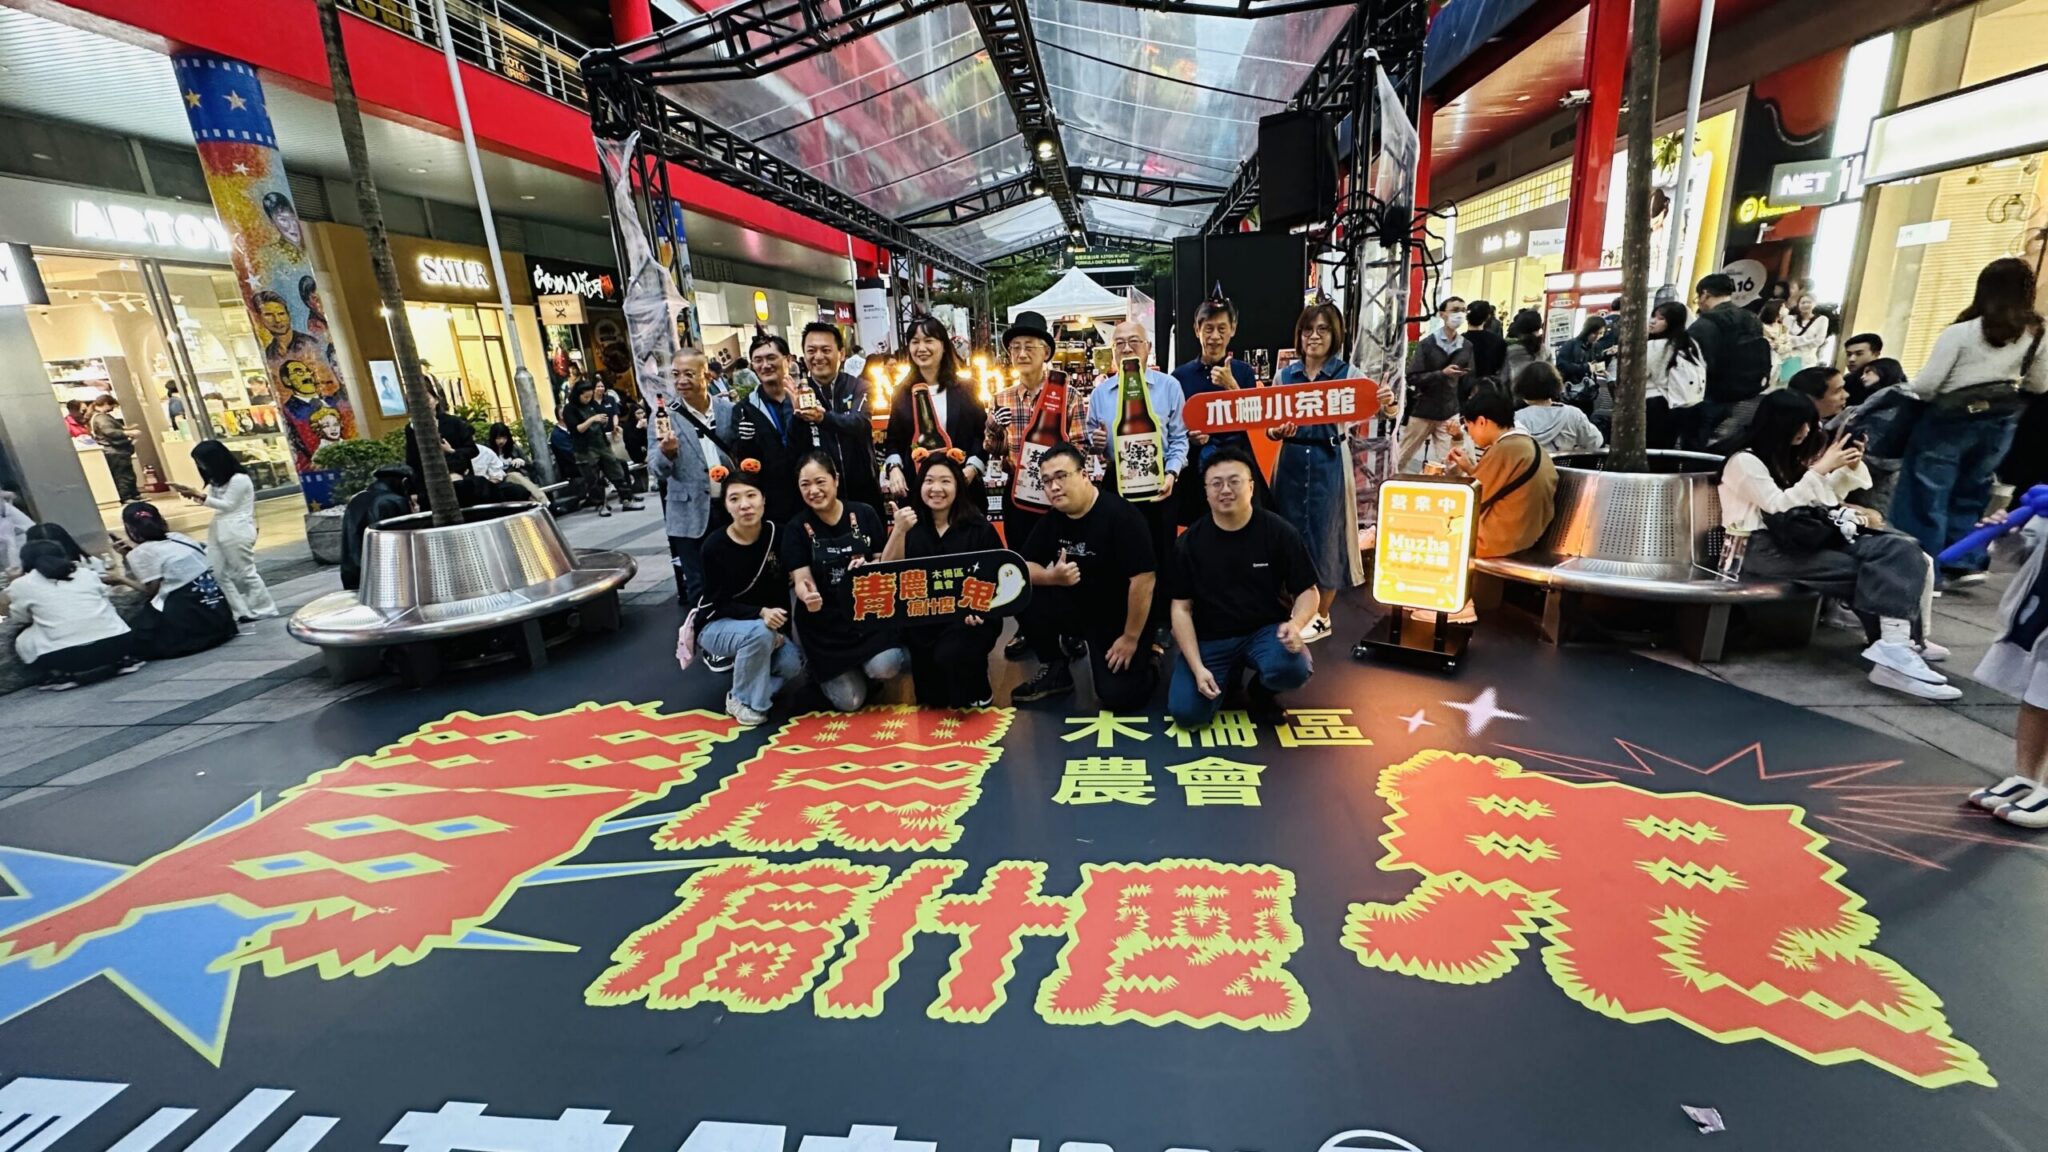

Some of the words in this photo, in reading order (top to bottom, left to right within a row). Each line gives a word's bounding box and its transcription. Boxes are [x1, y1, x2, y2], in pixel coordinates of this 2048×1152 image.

[1780, 171, 1831, 196] NET
[421, 255, 490, 288] SATUR
[1206, 386, 1357, 426] 木柵小茶館
[1388, 532, 1450, 553] Muzha
[958, 576, 997, 612] 鬼
[1060, 708, 1374, 748] 木柵區
[1051, 756, 1267, 806] 農會
[1340, 748, 1999, 1089] 鬼
